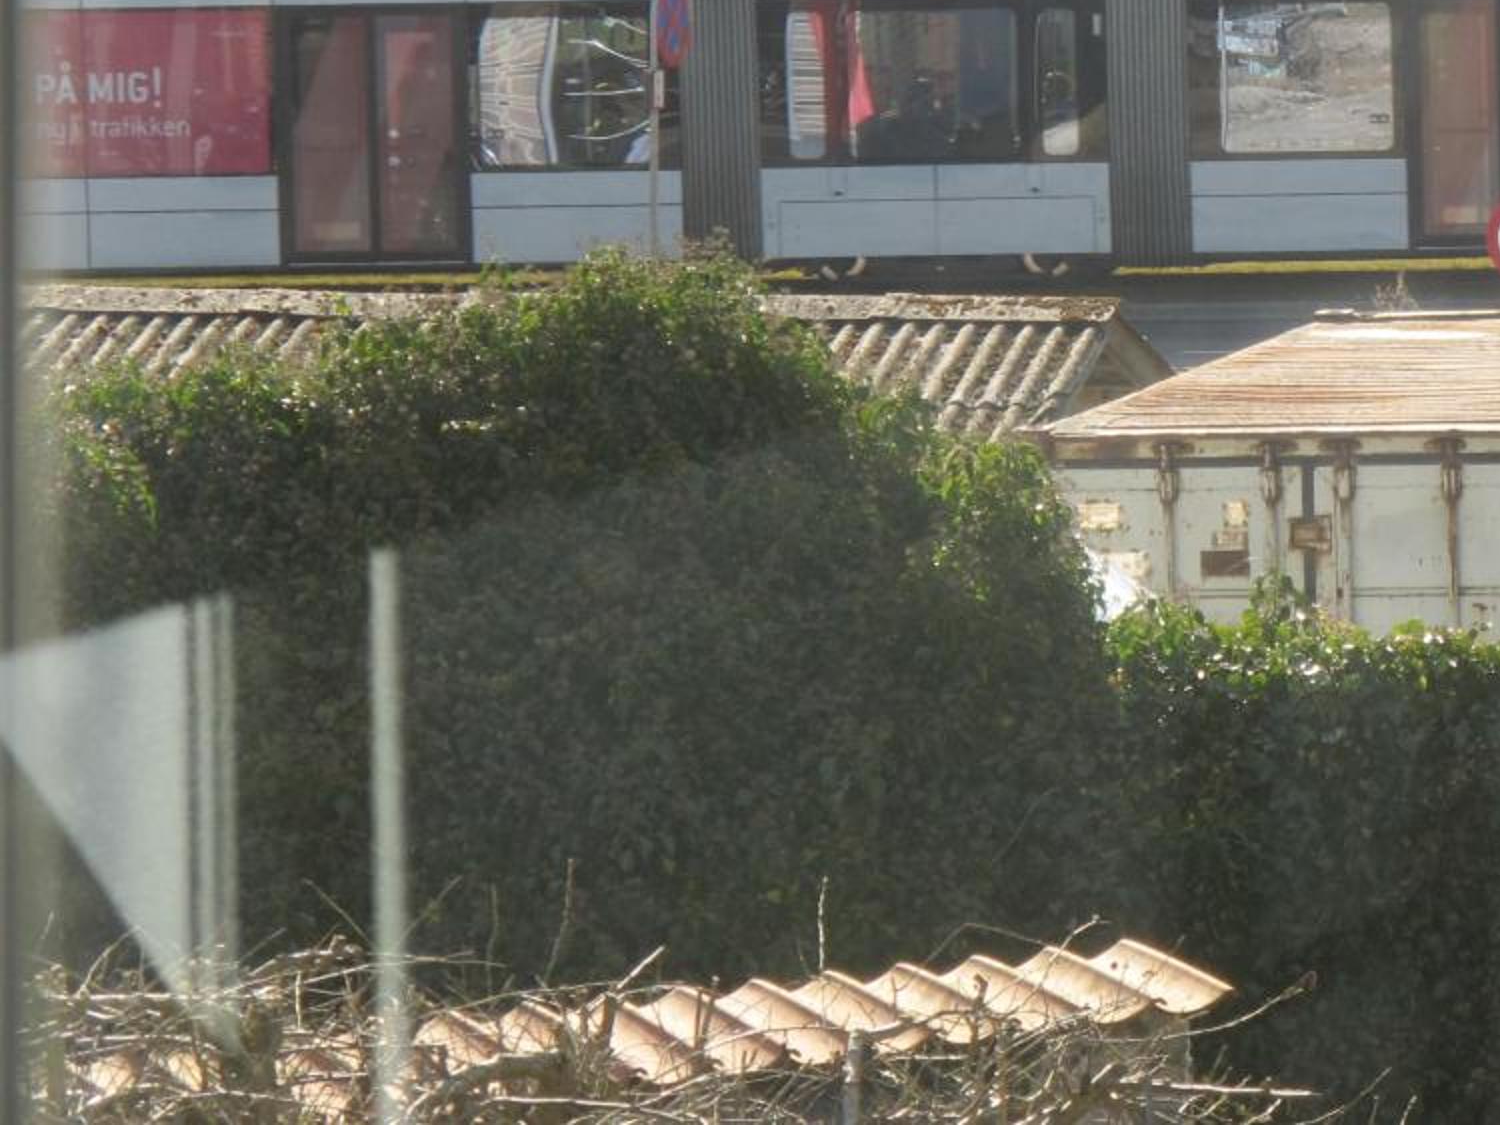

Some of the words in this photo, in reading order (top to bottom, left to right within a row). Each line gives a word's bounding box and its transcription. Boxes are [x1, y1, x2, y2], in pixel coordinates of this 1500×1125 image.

[34, 61, 77, 104] PÅ
[88, 67, 162, 108] MIG!
[91, 117, 191, 138] trafikken
